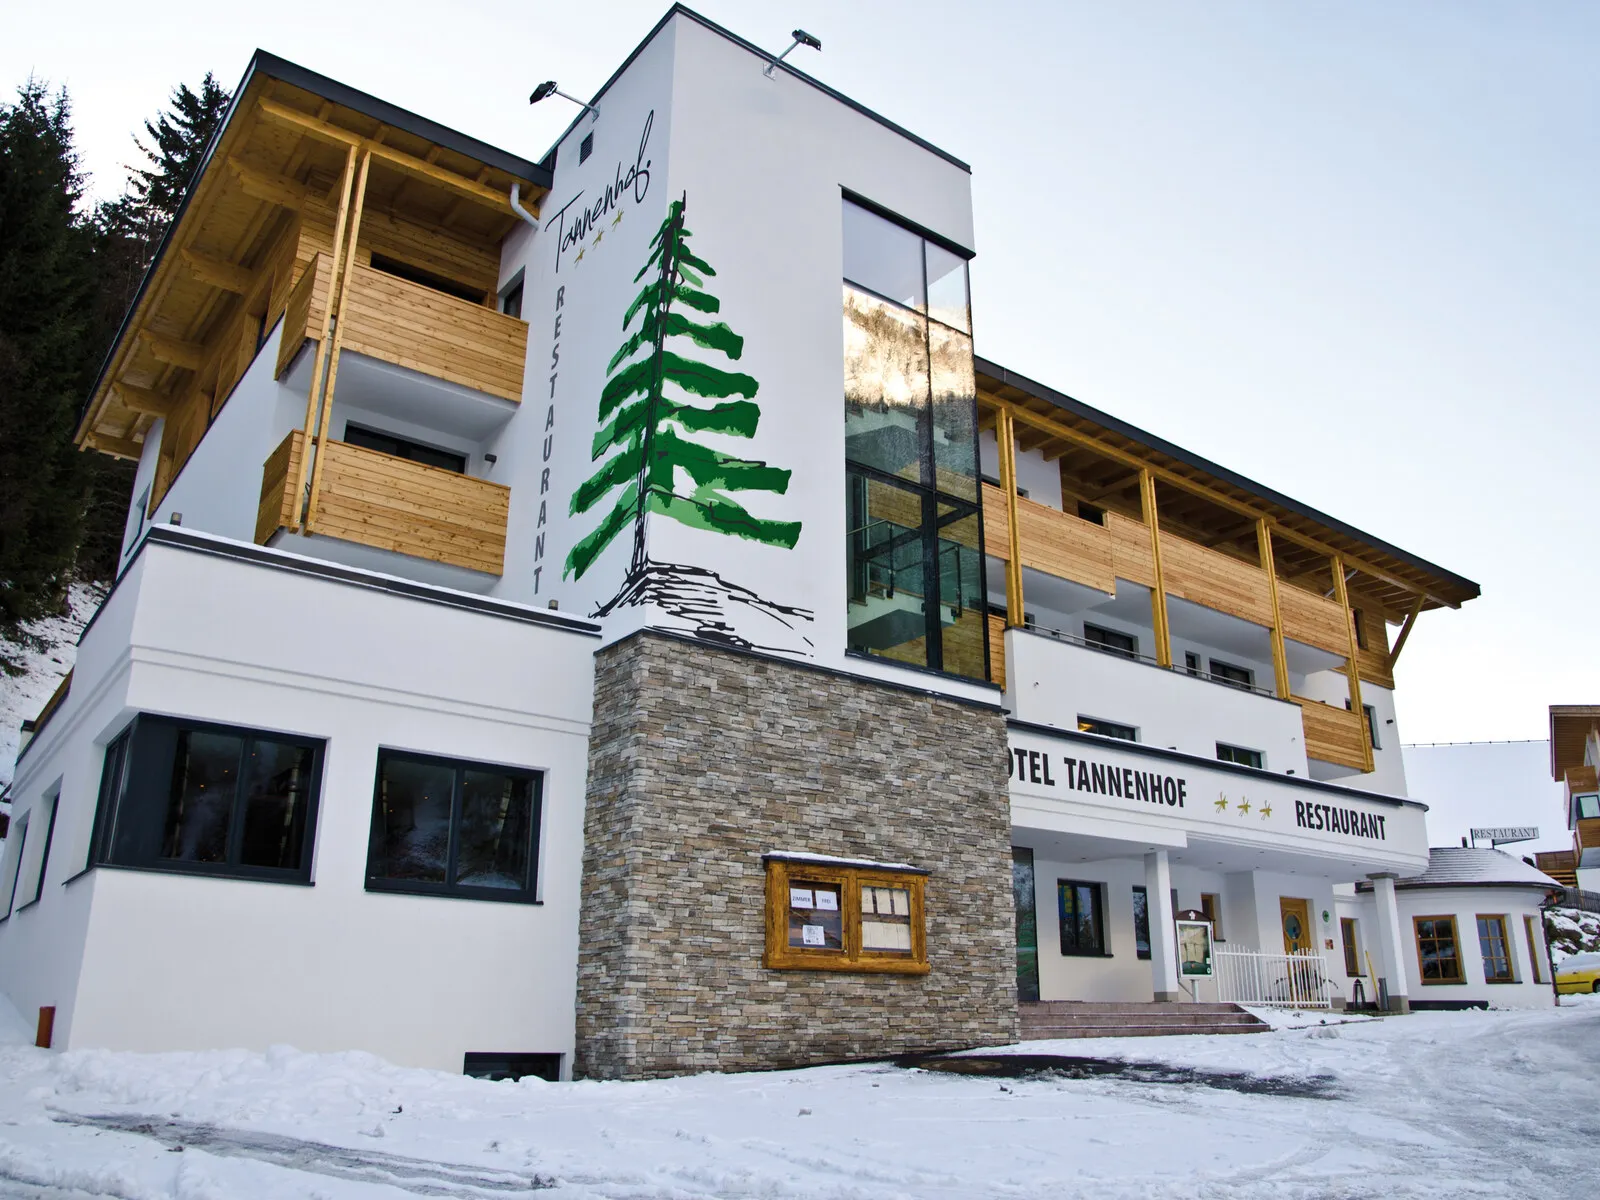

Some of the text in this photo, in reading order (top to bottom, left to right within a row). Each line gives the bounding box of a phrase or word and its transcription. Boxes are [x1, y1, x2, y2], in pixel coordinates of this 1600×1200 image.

[534, 285, 565, 595] RESTAURANT
[1064, 757, 1187, 808] TANNENHOF
[1296, 800, 1386, 840] RESTAURANT
[1474, 828, 1537, 839] RESTAURANT
